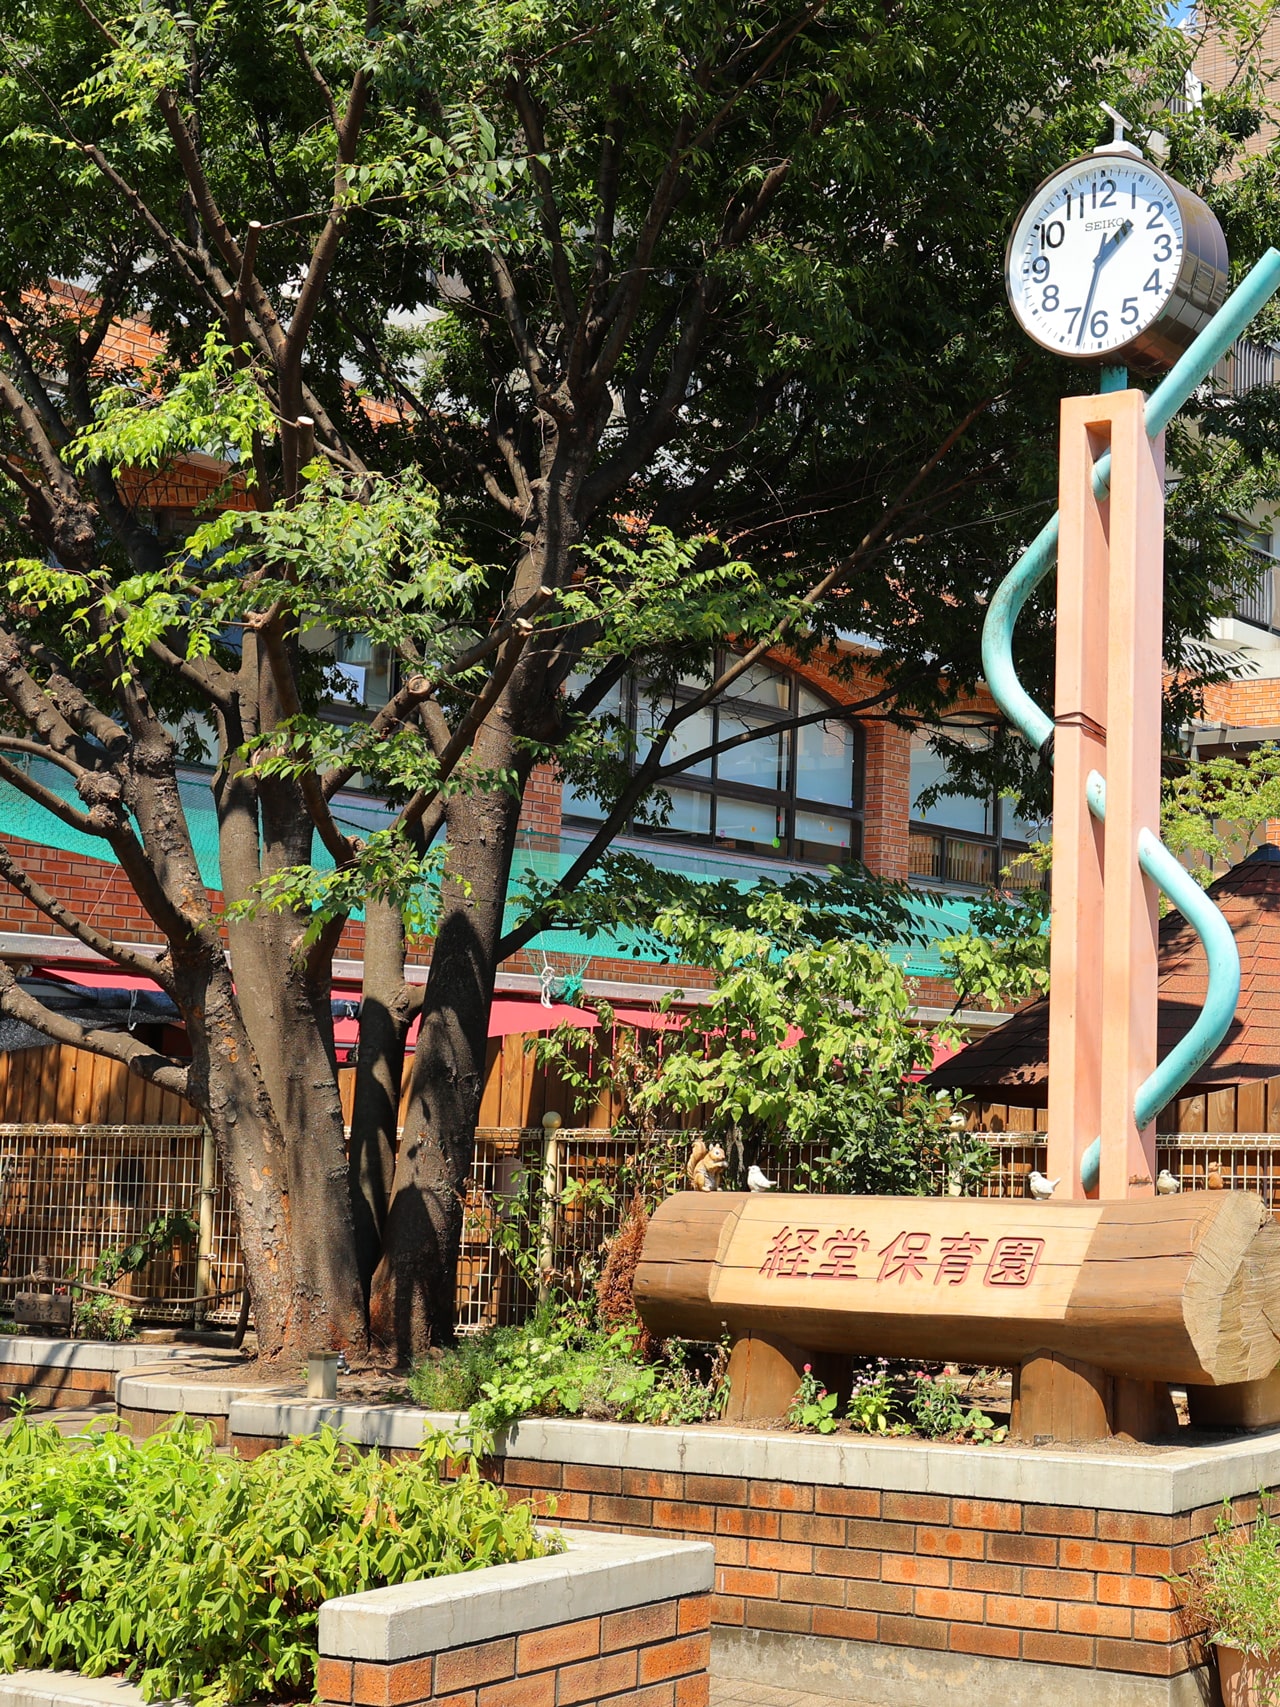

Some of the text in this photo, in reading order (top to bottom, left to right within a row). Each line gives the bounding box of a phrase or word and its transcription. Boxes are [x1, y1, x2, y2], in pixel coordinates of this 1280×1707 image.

[1066, 191, 1084, 221] 11
[1092, 179, 1117, 209] 12
[1131, 182, 1136, 209] 1
[1084, 217, 1125, 232] SEIKO
[1146, 201, 1164, 229] 2
[1040, 220, 1065, 250] 10
[1153, 234, 1172, 262] 3
[1032, 256, 1050, 283] 9
[1143, 268, 1162, 295] 4
[1041, 284, 1060, 312] 8
[1120, 297, 1139, 325] 5
[1064, 307, 1082, 334] 7
[1090, 310, 1109, 338] 6
[758, 1225, 1046, 1289] 経堂保育園
